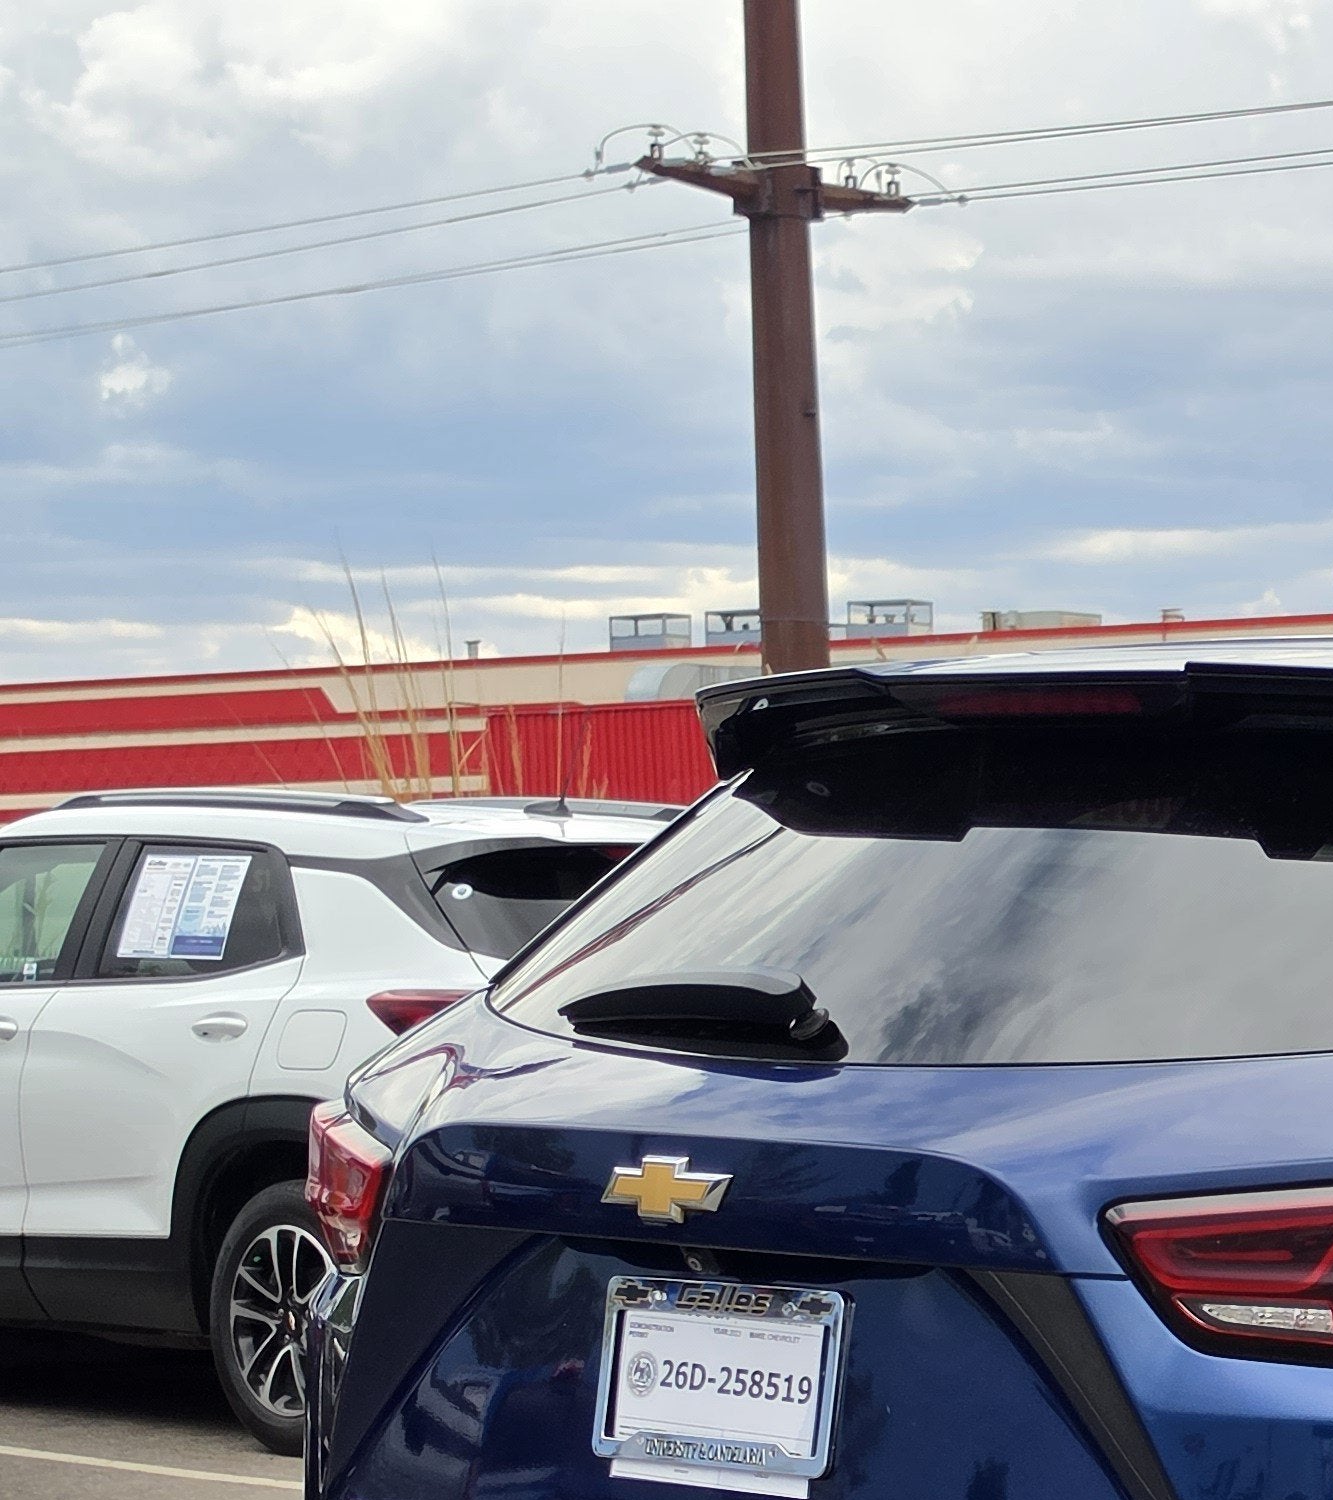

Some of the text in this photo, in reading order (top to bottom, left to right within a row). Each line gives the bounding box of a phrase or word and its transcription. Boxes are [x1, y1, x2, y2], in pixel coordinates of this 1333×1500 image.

[674, 1283, 772, 1315] Galles
[660, 1360, 812, 1404] 26D-258519
[644, 1438, 697, 1460] UNIVERSITY
[707, 1444, 766, 1466] CANDELARIA
